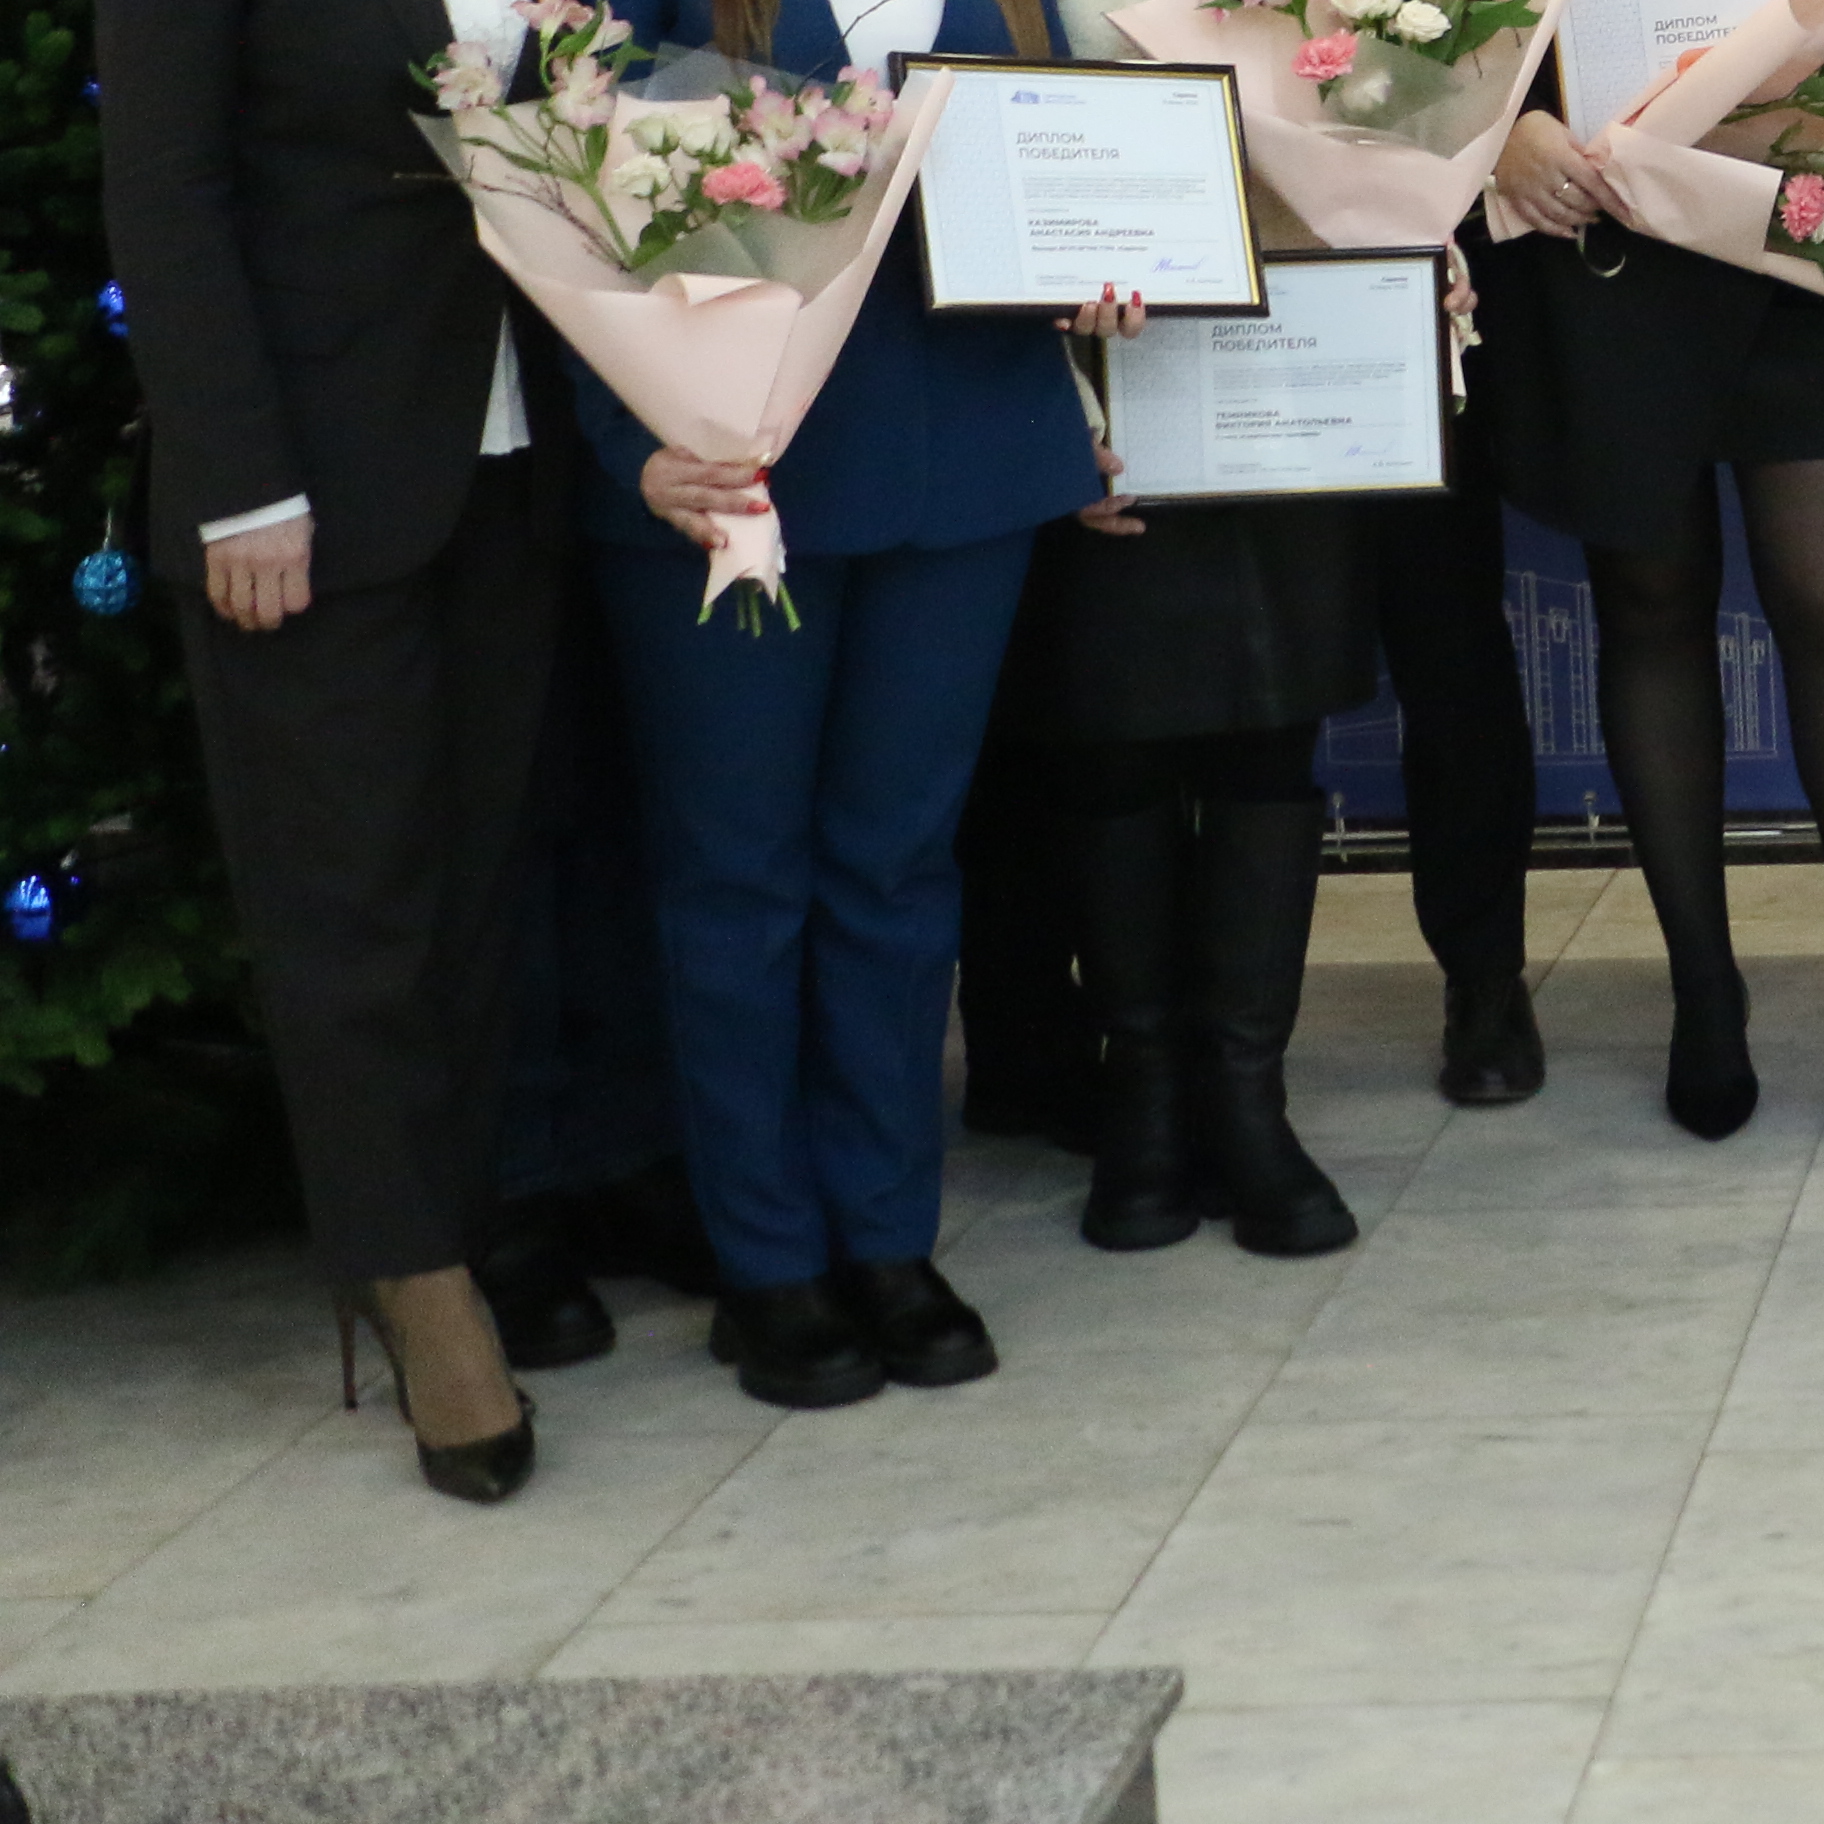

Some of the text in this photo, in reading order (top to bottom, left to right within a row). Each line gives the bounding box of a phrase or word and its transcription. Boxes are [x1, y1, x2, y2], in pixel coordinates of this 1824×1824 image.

[1653, 14, 1719, 32] ДИПЛОМ
[1016, 131, 1086, 145] ДИПЛОМ
[1018, 147, 1121, 161] ПОБЕДИТЕЛЯ
[1211, 323, 1283, 338] ДИПЛОМ
[1211, 337, 1318, 353] ПОБЕДИТЕЛЯ
